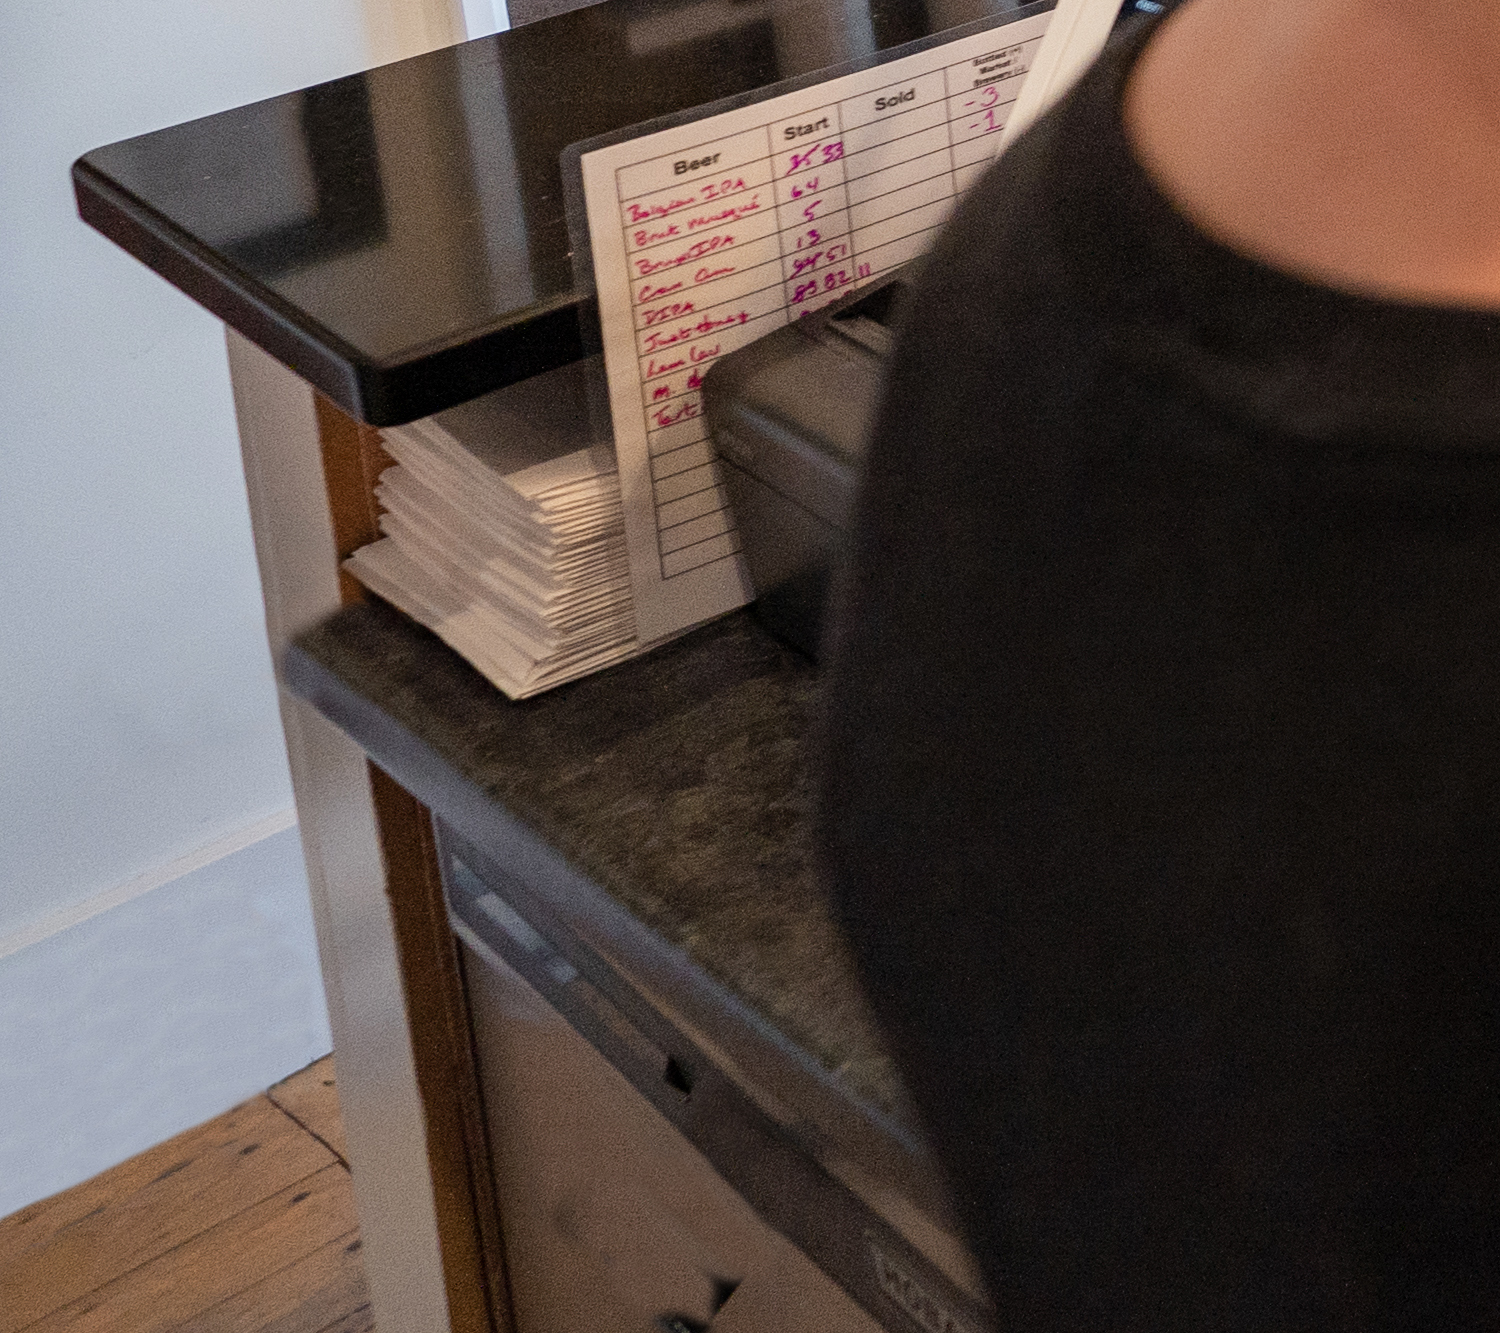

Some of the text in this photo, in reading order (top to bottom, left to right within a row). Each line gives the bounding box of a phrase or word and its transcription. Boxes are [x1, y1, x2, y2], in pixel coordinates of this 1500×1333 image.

[673, 87, 916, 176] Beer Start Sold
[701, 177, 746, 201] IPA
[791, 176, 820, 199] 64
[802, 199, 823, 222] 5
[796, 228, 822, 249] 13
[641, 301, 695, 325] DIPA
